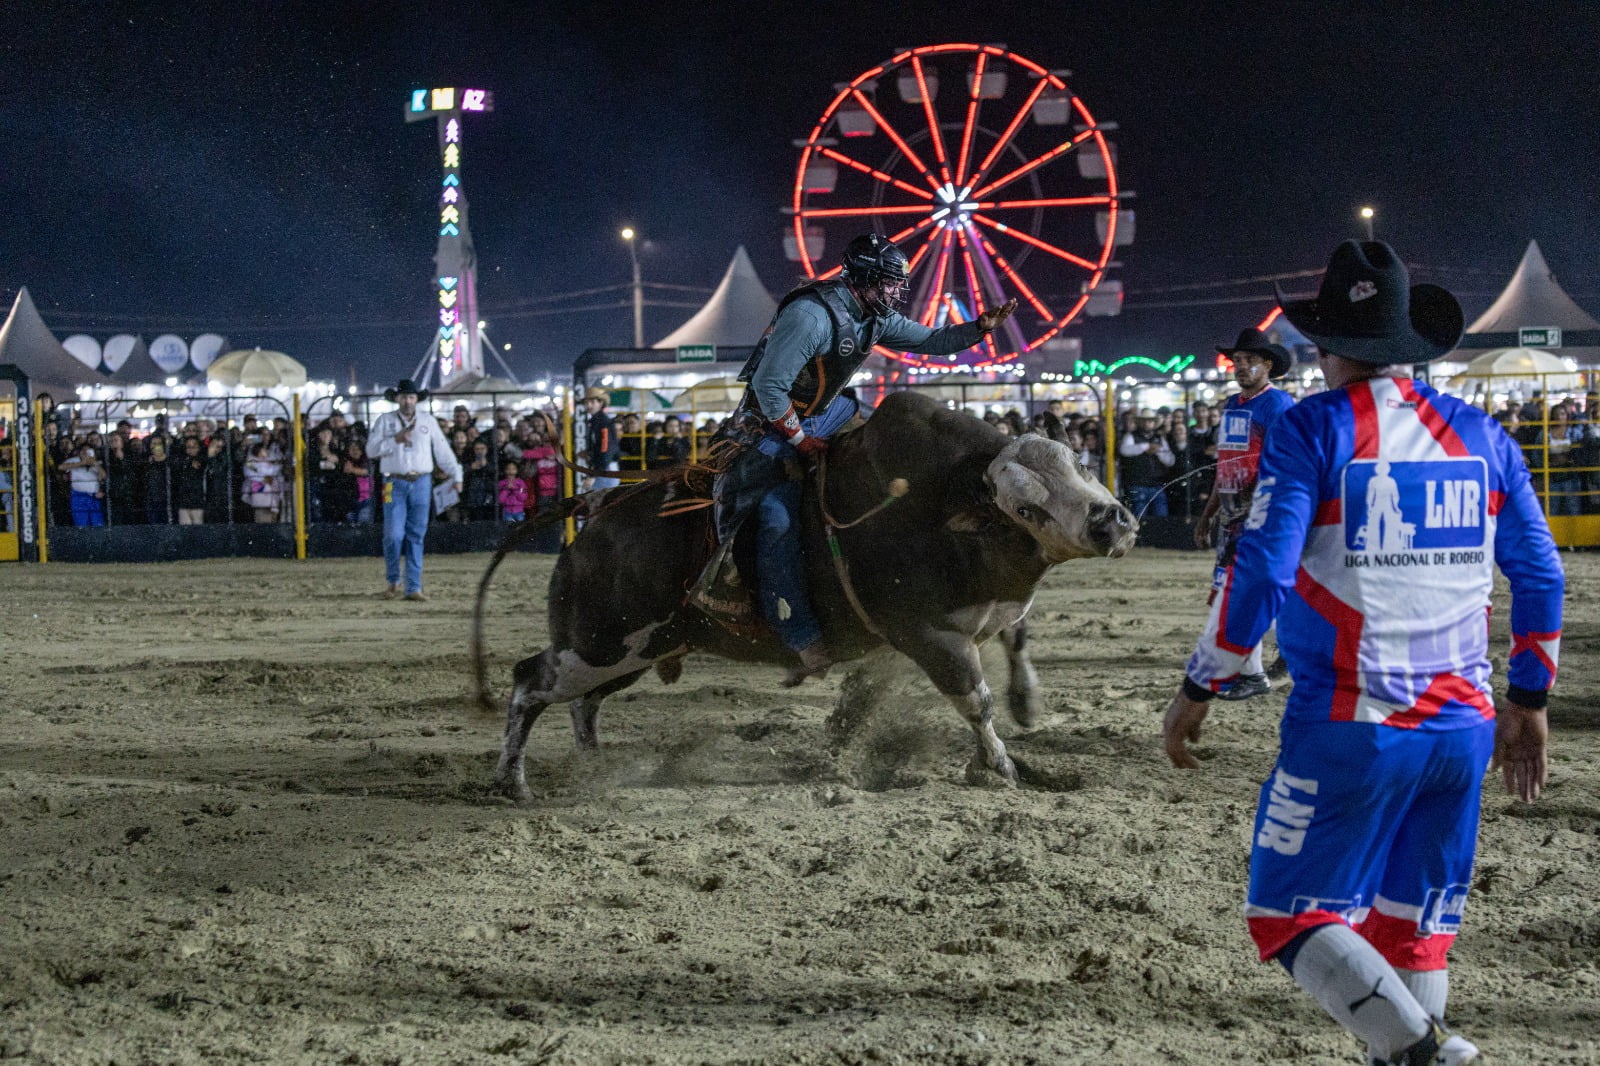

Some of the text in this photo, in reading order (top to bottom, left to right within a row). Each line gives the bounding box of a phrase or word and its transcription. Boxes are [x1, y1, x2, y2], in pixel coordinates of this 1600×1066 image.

[18, 397, 28, 414] 3
[1425, 480, 1480, 528] LNR
[1344, 551, 1485, 567] LIGA NACIONAL DE RODEIO
[1258, 767, 1318, 855] LNR
